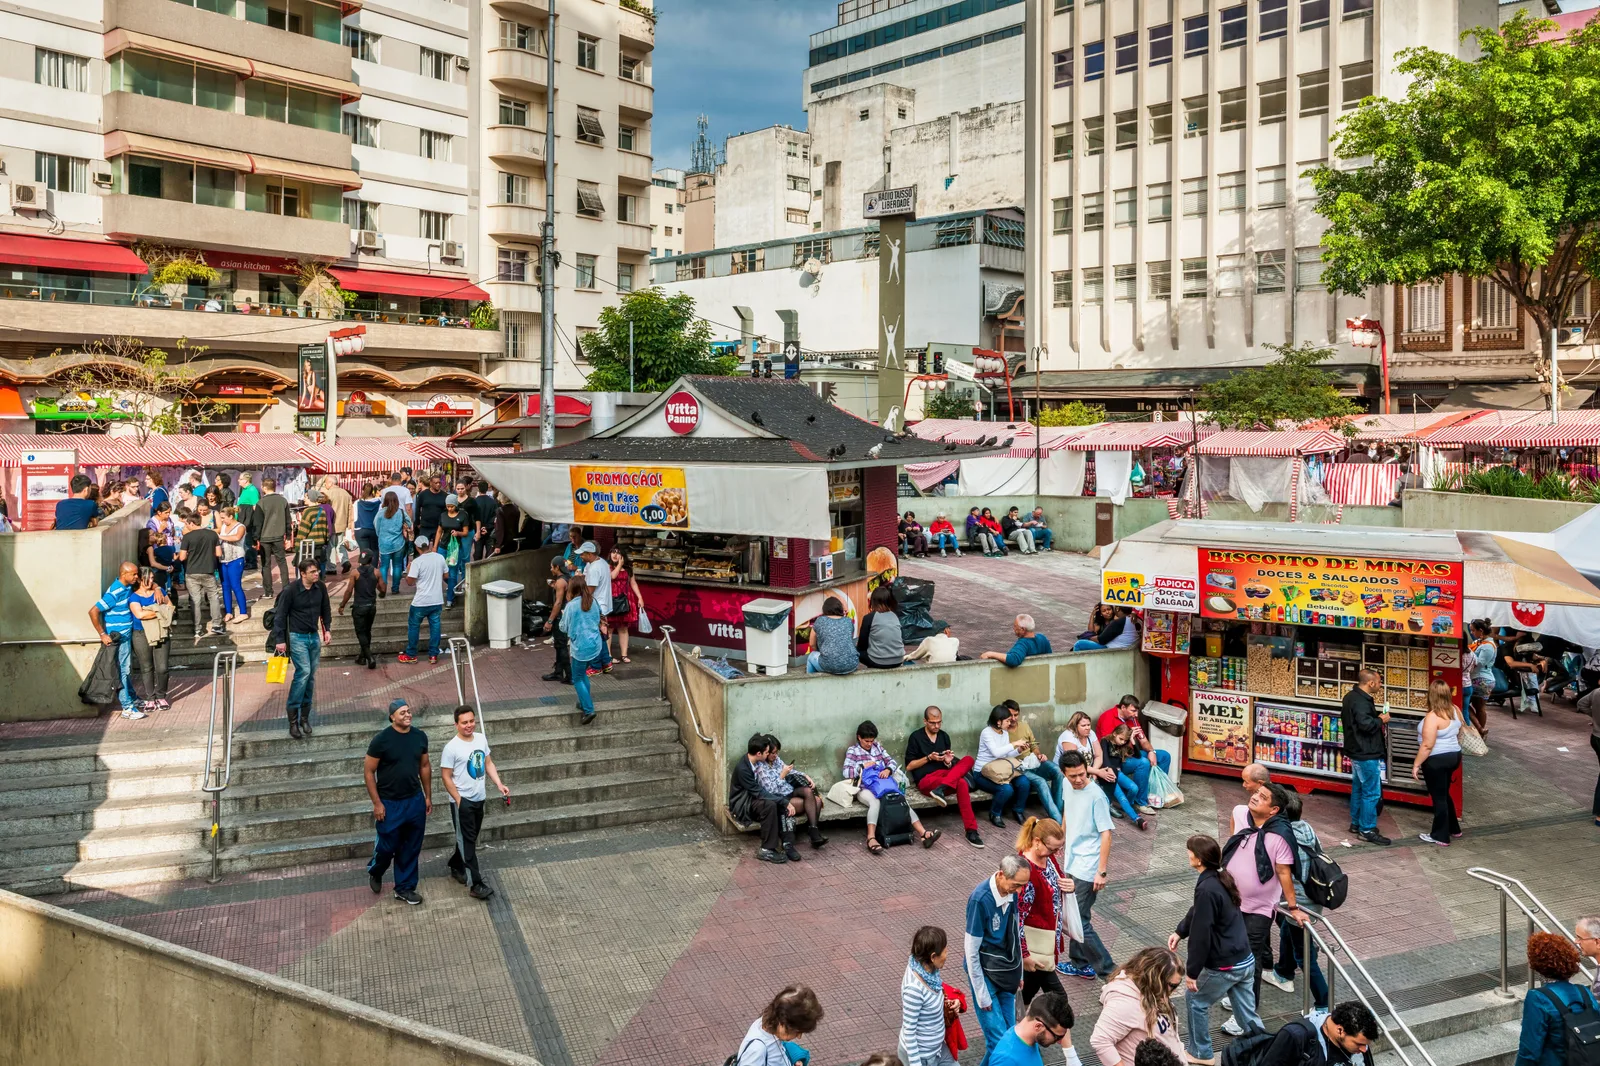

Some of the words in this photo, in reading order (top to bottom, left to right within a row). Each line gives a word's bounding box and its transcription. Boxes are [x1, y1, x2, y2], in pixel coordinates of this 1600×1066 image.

[882, 198, 909, 210] LIBERDADE
[220, 260, 242, 268] asian
[243, 261, 271, 271] kitchen
[667, 403, 697, 415] Vitta
[1137, 402, 1152, 411] Ho
[1156, 402, 1179, 411] Kim
[667, 414, 697, 424] Panne
[586, 470, 663, 488] PROMOÇÃO!
[576, 491, 589, 501] 10
[592, 491, 613, 502] Mini
[617, 492, 639, 503] Pães
[593, 502, 605, 512] de
[608, 503, 639, 516] Queijo
[642, 509, 664, 521] 1,00
[1208, 551, 1319, 568] BISCOITO
[1325, 557, 1358, 570] DE
[1365, 560, 1451, 576] MINAS
[1107, 576, 1127, 585] TEMOS
[1257, 570, 1302, 579] DOCES
[1322, 573, 1399, 585] SALGADOS
[1412, 576, 1457, 586] Salgadinhos
[1156, 579, 1194, 589] TAPIOCA
[1159, 589, 1184, 597] DOCE
[1155, 597, 1194, 608] SALGADA
[1306, 603, 1345, 612] Bebidas
[707, 623, 743, 640] Vitta
[1195, 692, 1248, 704] PROMOÇÃO
[1199, 703, 1243, 719] MEL
[1210, 717, 1243, 725] ABELHAS
